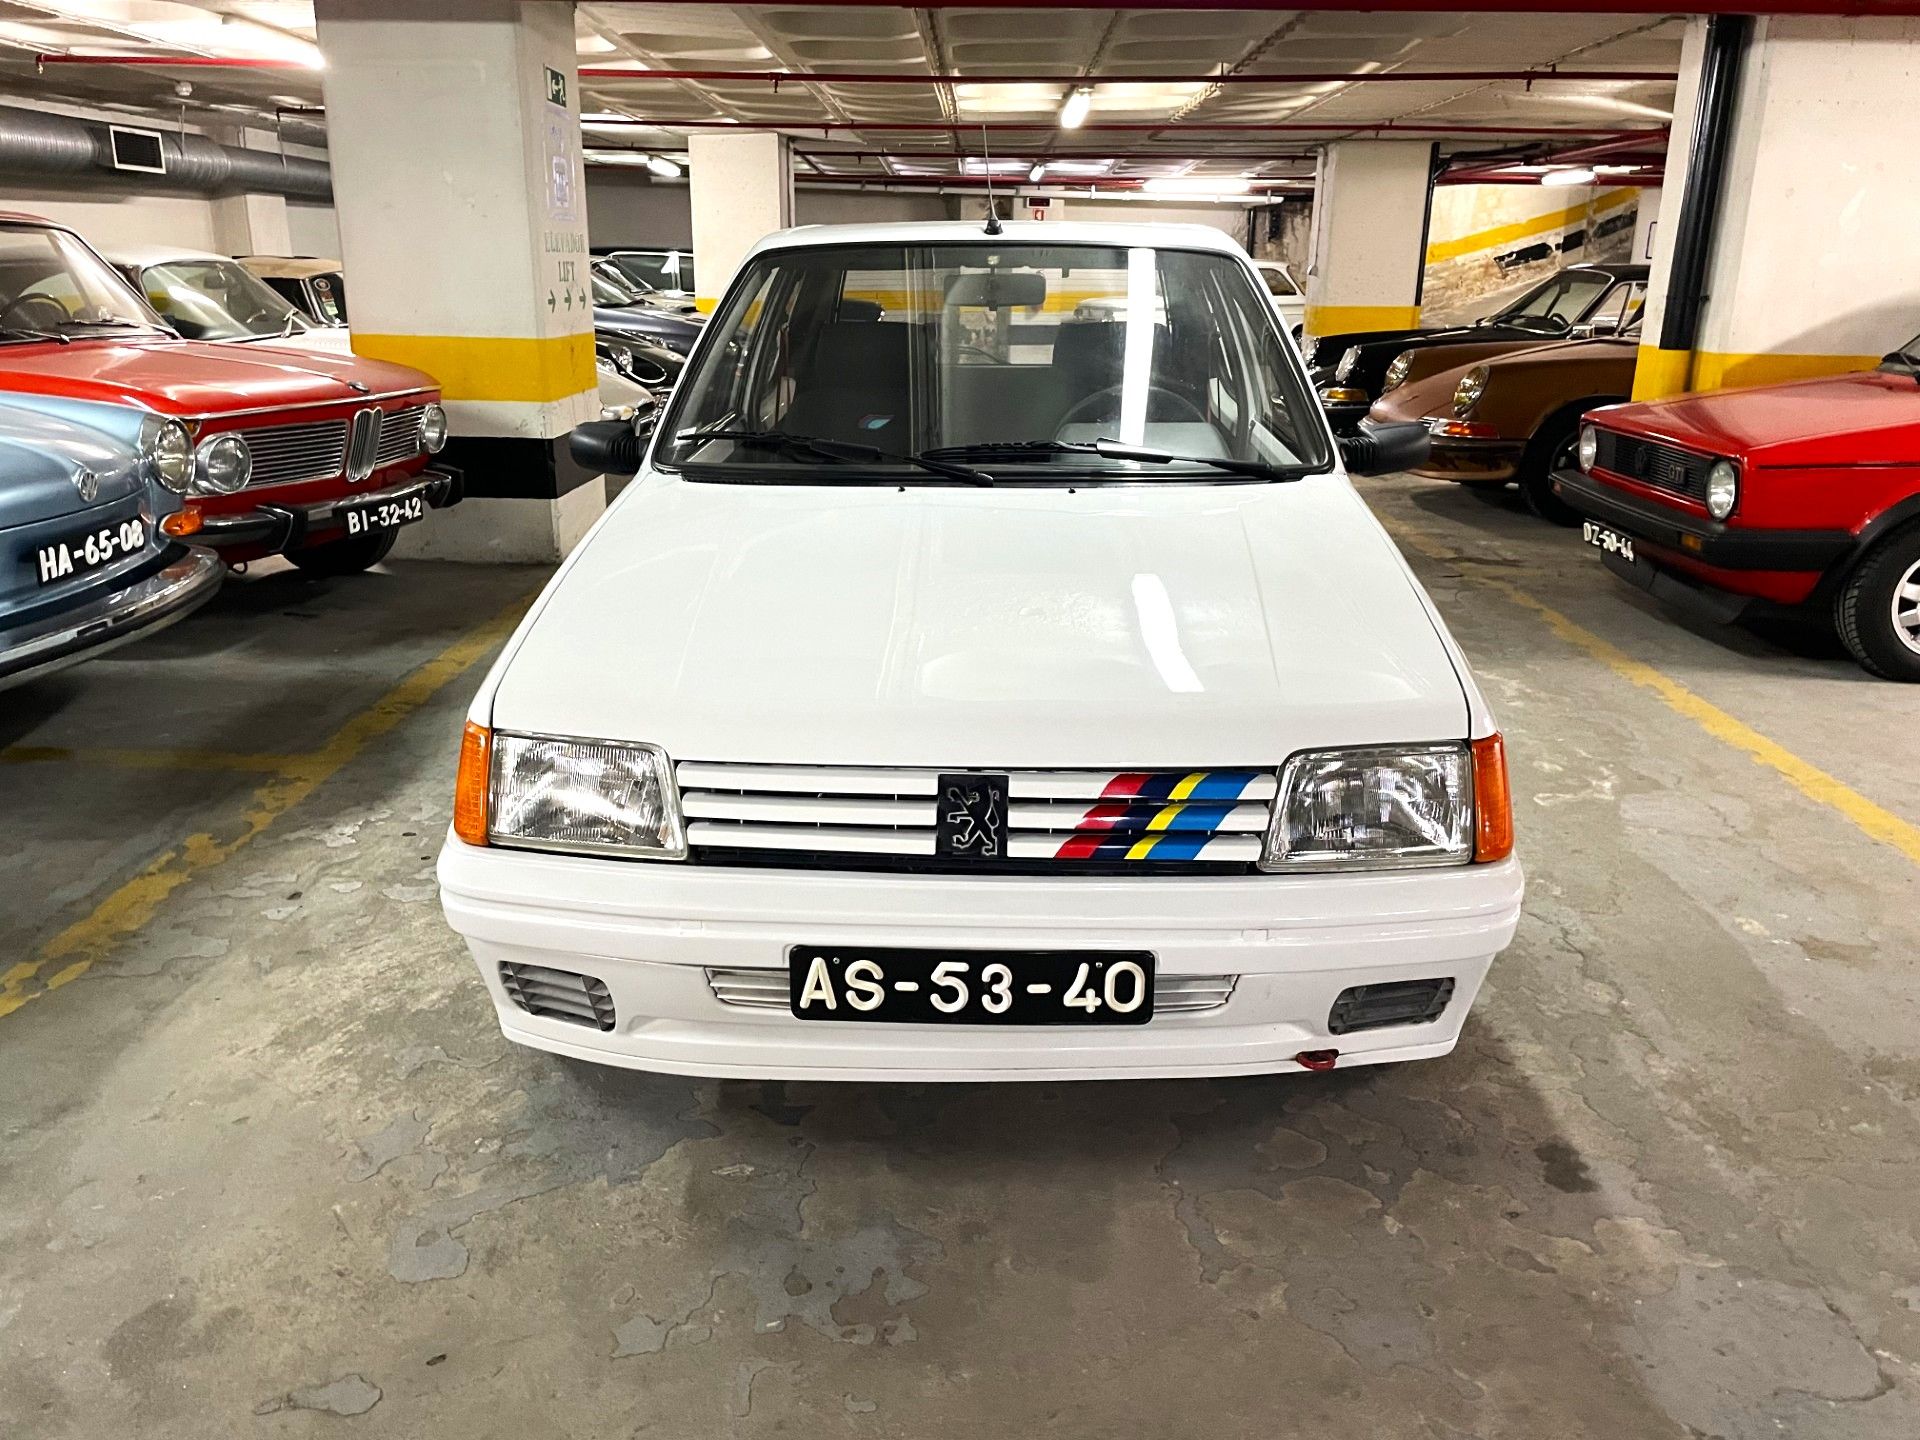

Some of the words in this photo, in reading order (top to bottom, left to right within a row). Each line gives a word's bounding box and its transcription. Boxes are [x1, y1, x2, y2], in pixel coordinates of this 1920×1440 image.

[558, 261, 575, 282] LIFT
[347, 497, 422, 535] BI-32-42
[39, 519, 145, 583] HA-65-08
[799, 957, 1146, 1014] AS-53-40
